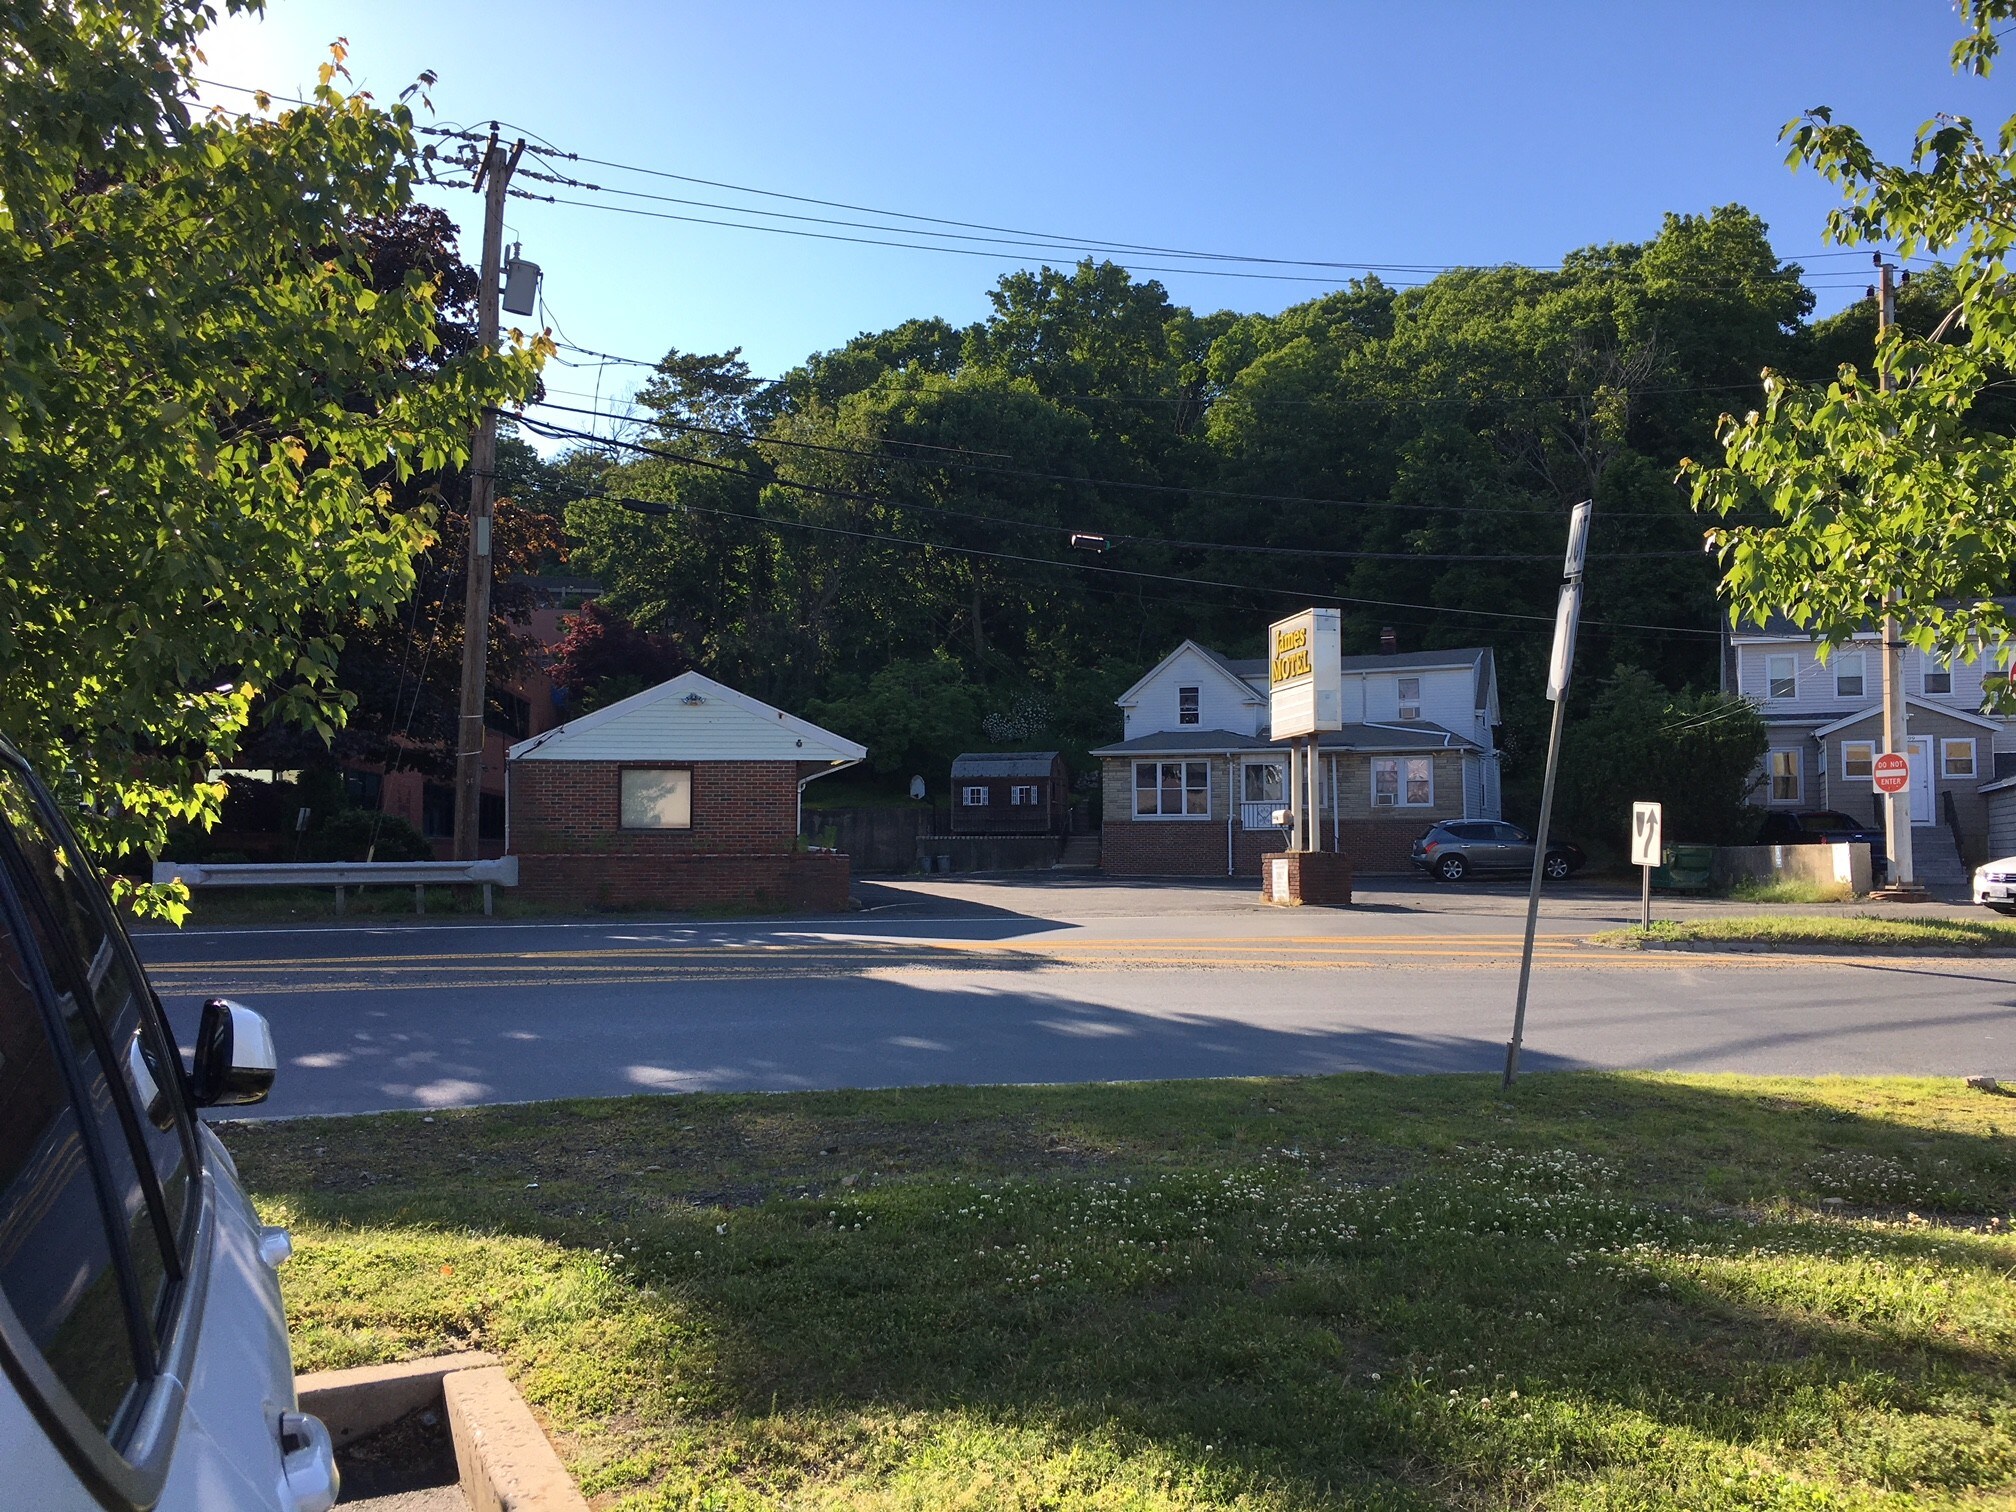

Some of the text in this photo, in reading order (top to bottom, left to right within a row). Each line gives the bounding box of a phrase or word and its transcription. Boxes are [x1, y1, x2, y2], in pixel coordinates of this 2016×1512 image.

[1567, 514, 1589, 564] JCT
[1276, 628, 1306, 659] James
[1273, 650, 1312, 682] MOTEL
[1878, 760, 1903, 769] DO NOT
